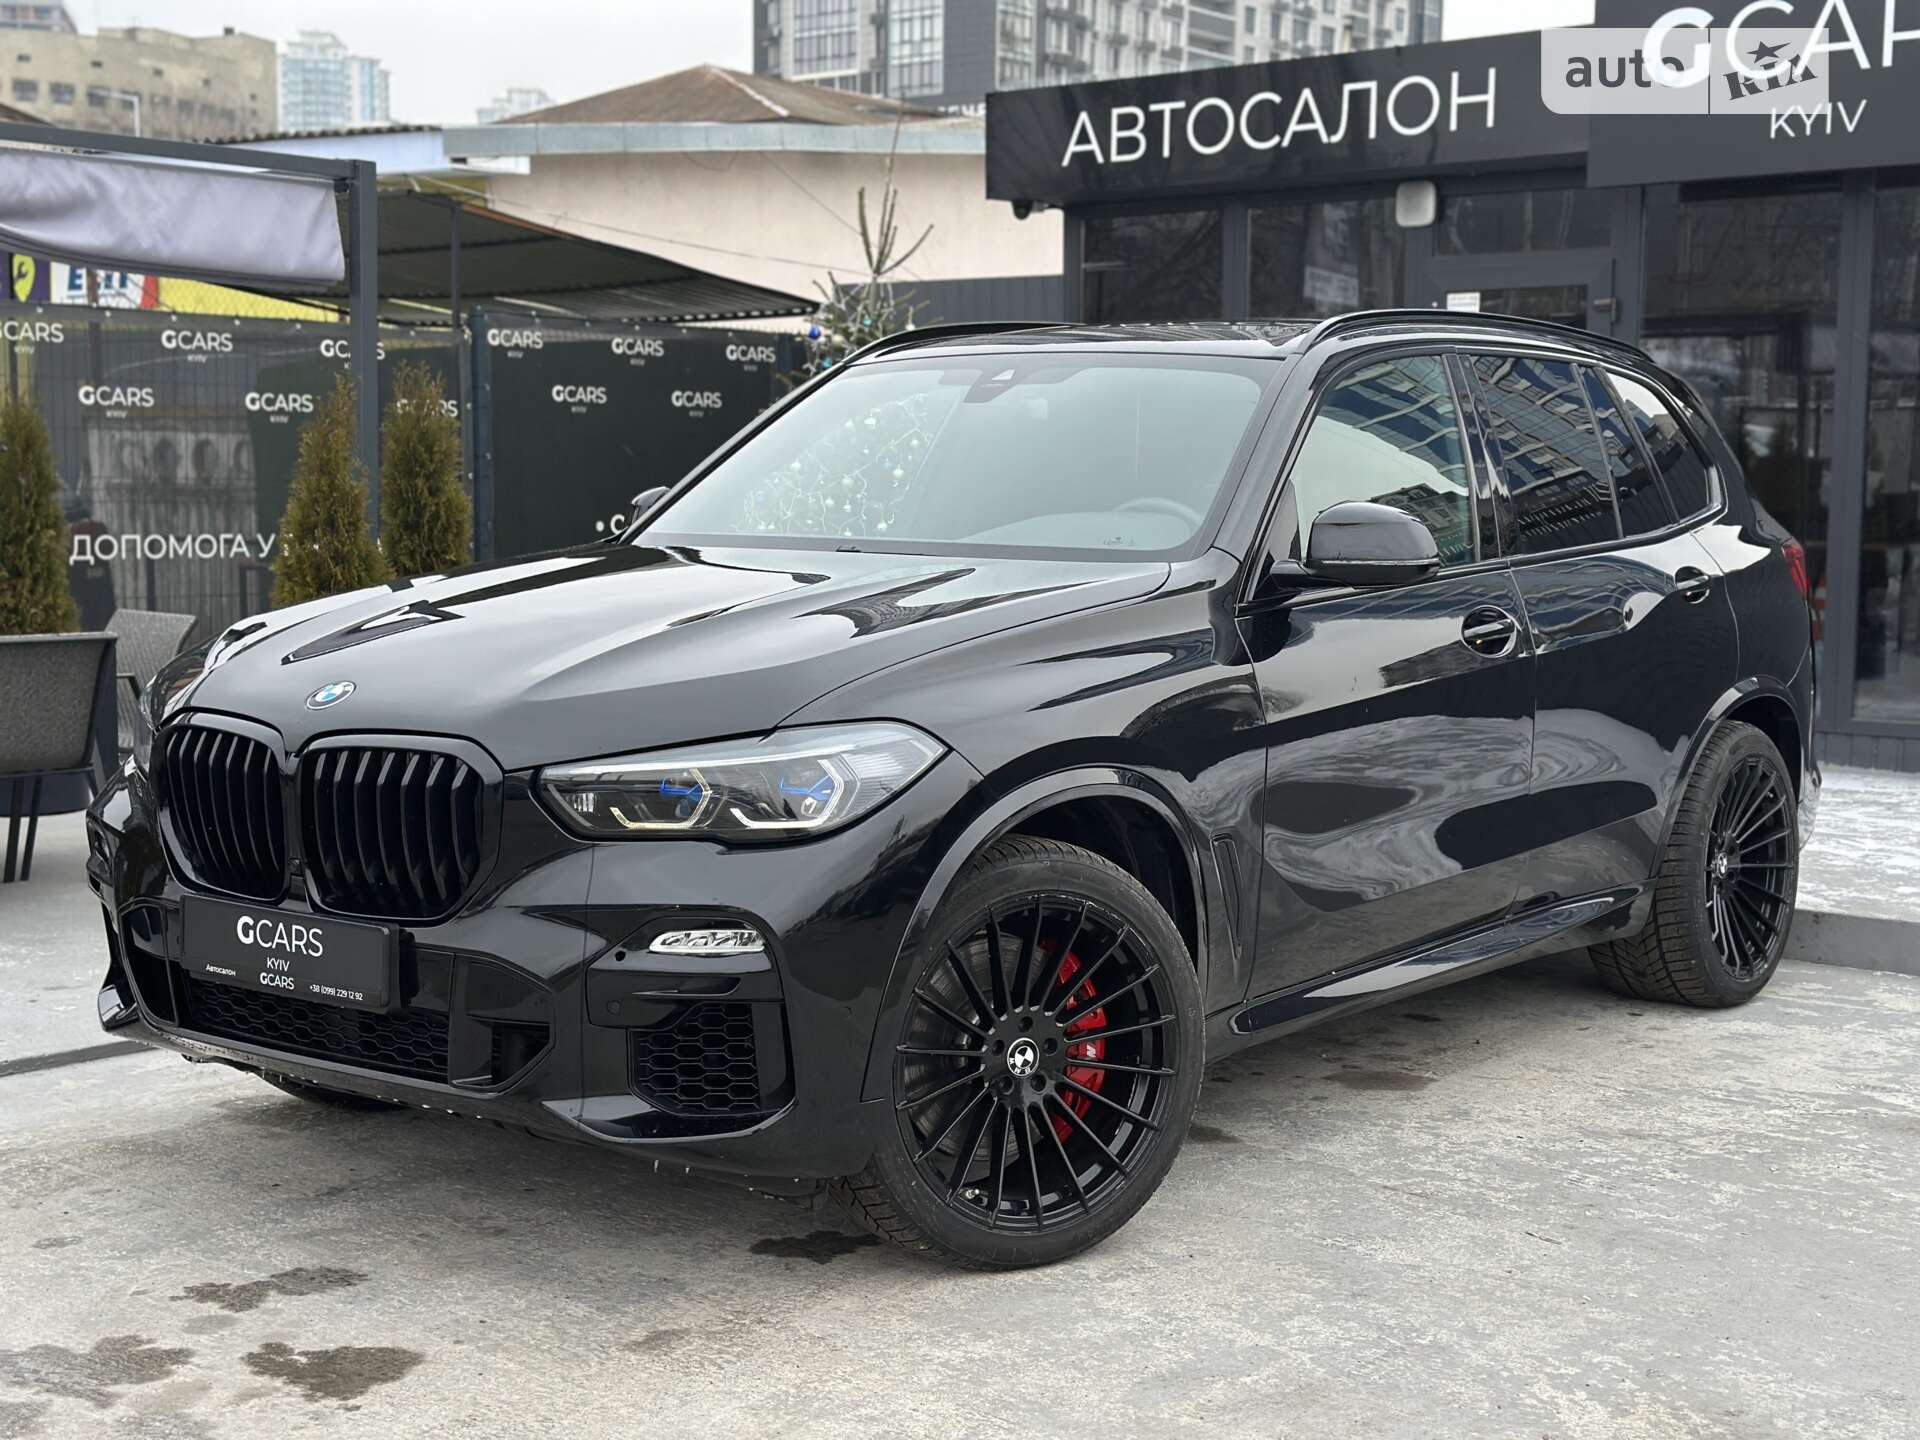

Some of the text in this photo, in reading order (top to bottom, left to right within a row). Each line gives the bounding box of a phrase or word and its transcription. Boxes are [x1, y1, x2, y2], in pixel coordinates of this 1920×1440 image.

[1061, 67, 1496, 168] АВТОСАЛОН
[1769, 99, 1867, 139] KYIV
[161, 330, 233, 352] GCARS
[487, 328, 543, 349] GCARS
[611, 337, 664, 357] GCARS
[320, 339, 386, 360] GCS
[726, 344, 776, 363] GCARS
[78, 385, 154, 408] GCARS
[245, 392, 314, 413] GCARS
[552, 384, 608, 404] GCARS
[671, 390, 722, 409] GCARS
[69, 533, 250, 566] ДОПОМОГА
[236, 915, 323, 957] GCARS
[266, 956, 290, 972] KYIV
[260, 972, 295, 990] GCARS
[310, 984, 320, 993] +38
